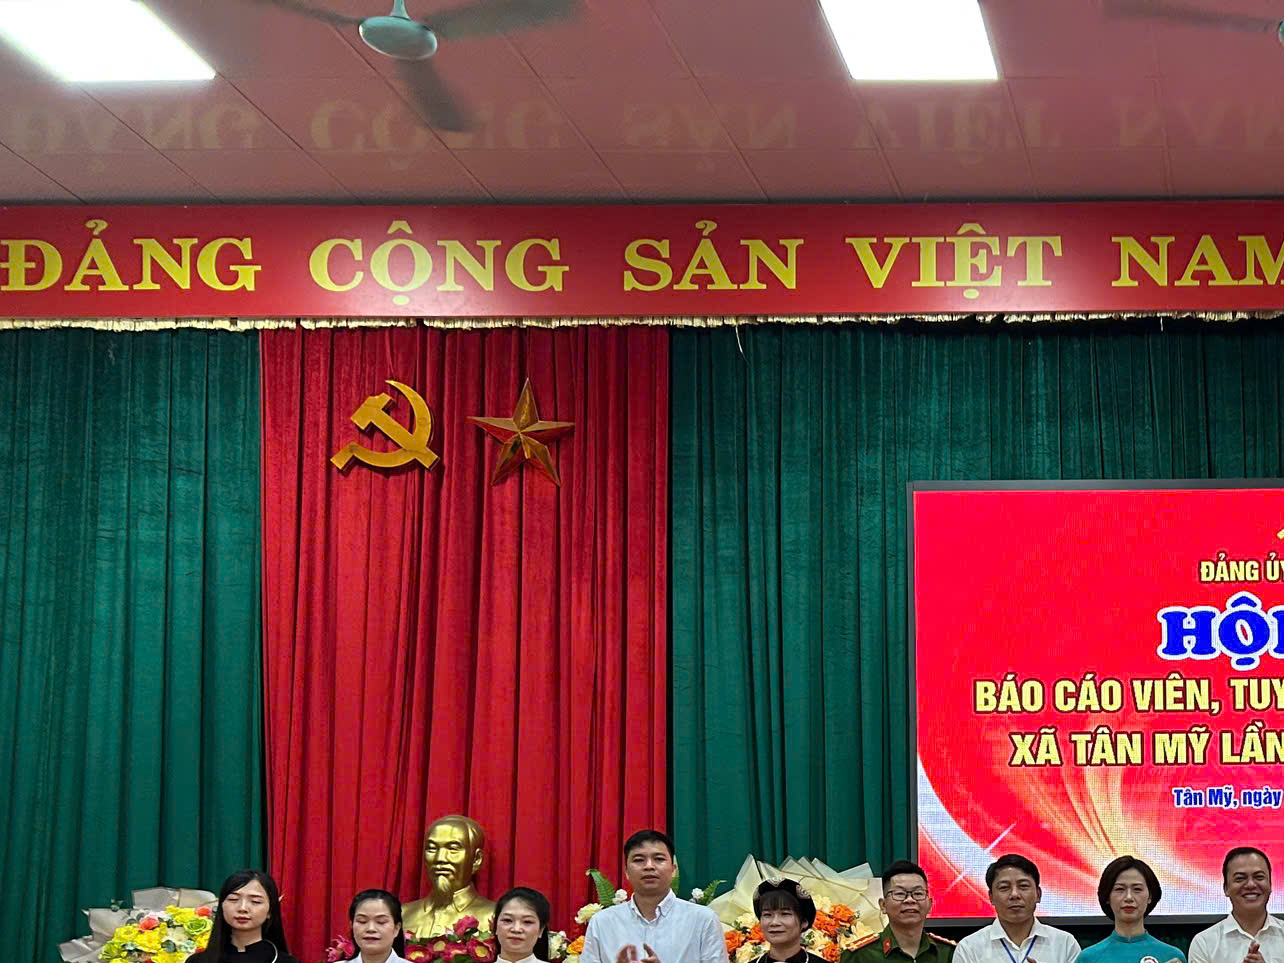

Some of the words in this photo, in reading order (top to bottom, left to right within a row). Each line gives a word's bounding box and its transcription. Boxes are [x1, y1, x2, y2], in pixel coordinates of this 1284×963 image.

[0, 219, 261, 292] ĐẢNG
[309, 220, 569, 306] CỘNG
[623, 219, 804, 291] SẢN
[845, 223, 1063, 300] VIỆT
[1201, 553, 1259, 582] ĐẢNG
[975, 674, 1043, 712] BÁO
[1055, 673, 1122, 712] CÁO
[1132, 672, 1220, 714] VIÊN,
[1009, 728, 1061, 765] XÃ
[1071, 726, 1142, 765] TÂN
[1154, 726, 1210, 764] MỸ
[1174, 788, 1203, 806] Tân
[1208, 787, 1238, 808] Mỹ,
[1242, 788, 1281, 808] ngày
